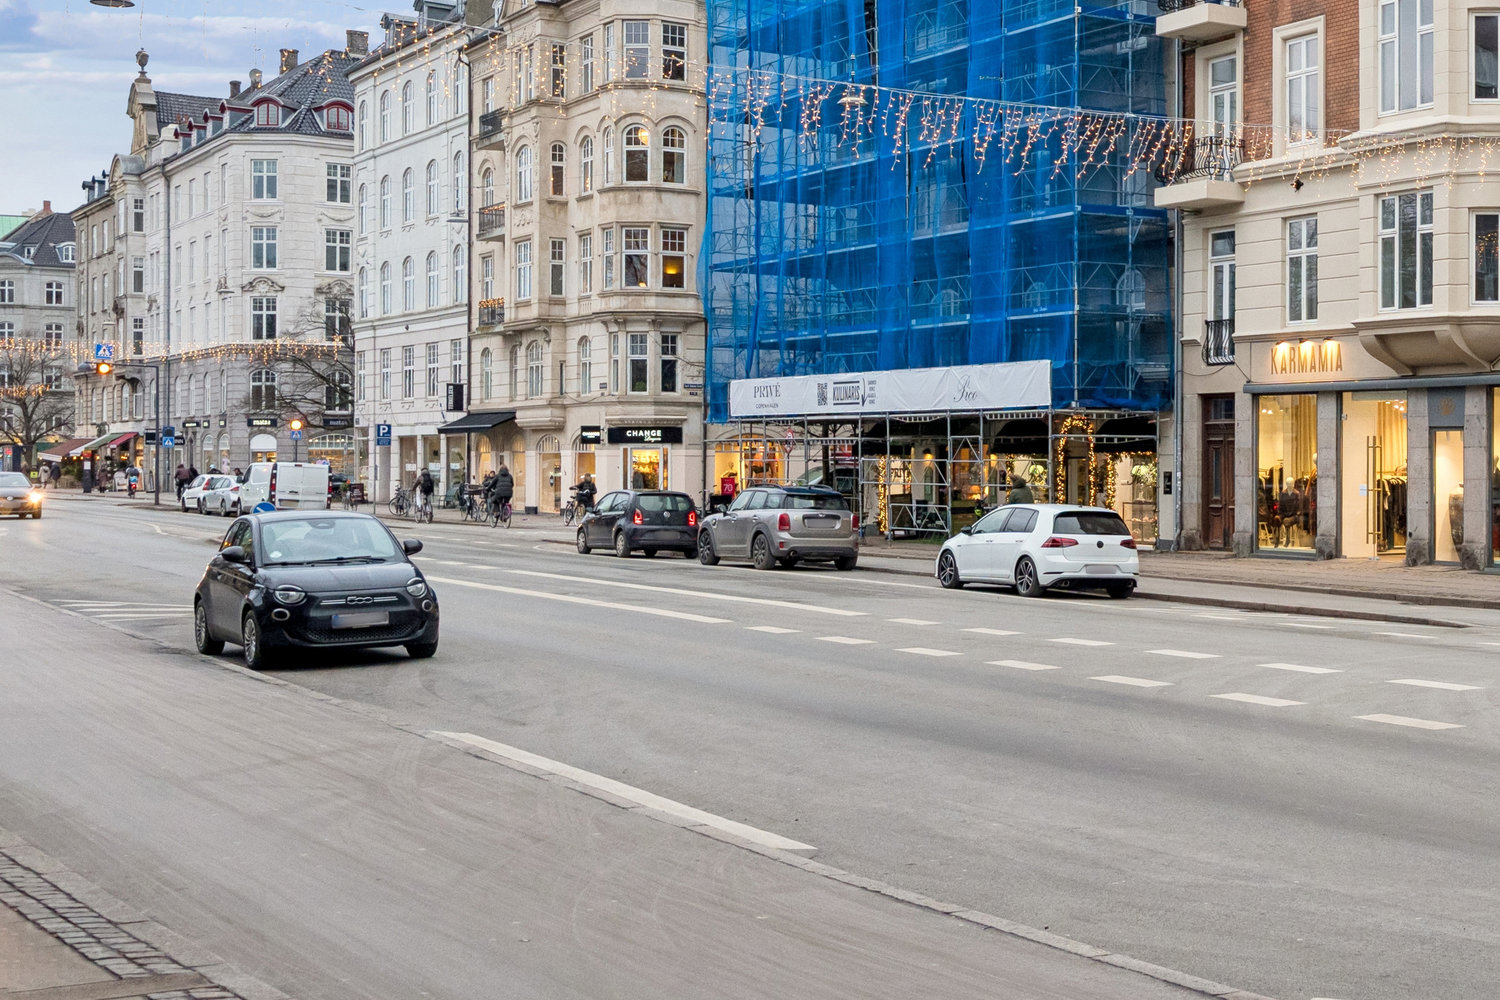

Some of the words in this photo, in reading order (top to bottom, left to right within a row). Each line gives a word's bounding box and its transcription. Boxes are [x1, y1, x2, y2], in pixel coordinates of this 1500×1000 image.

[1271, 343, 1343, 375] KARMAMIA
[753, 383, 781, 398] PRIVÉ
[832, 385, 861, 401] KULINARIS
[379, 425, 389, 436] P
[626, 429, 662, 437] CHANGE
[723, 483, 734, 492] 70
[347, 596, 373, 604] 500
